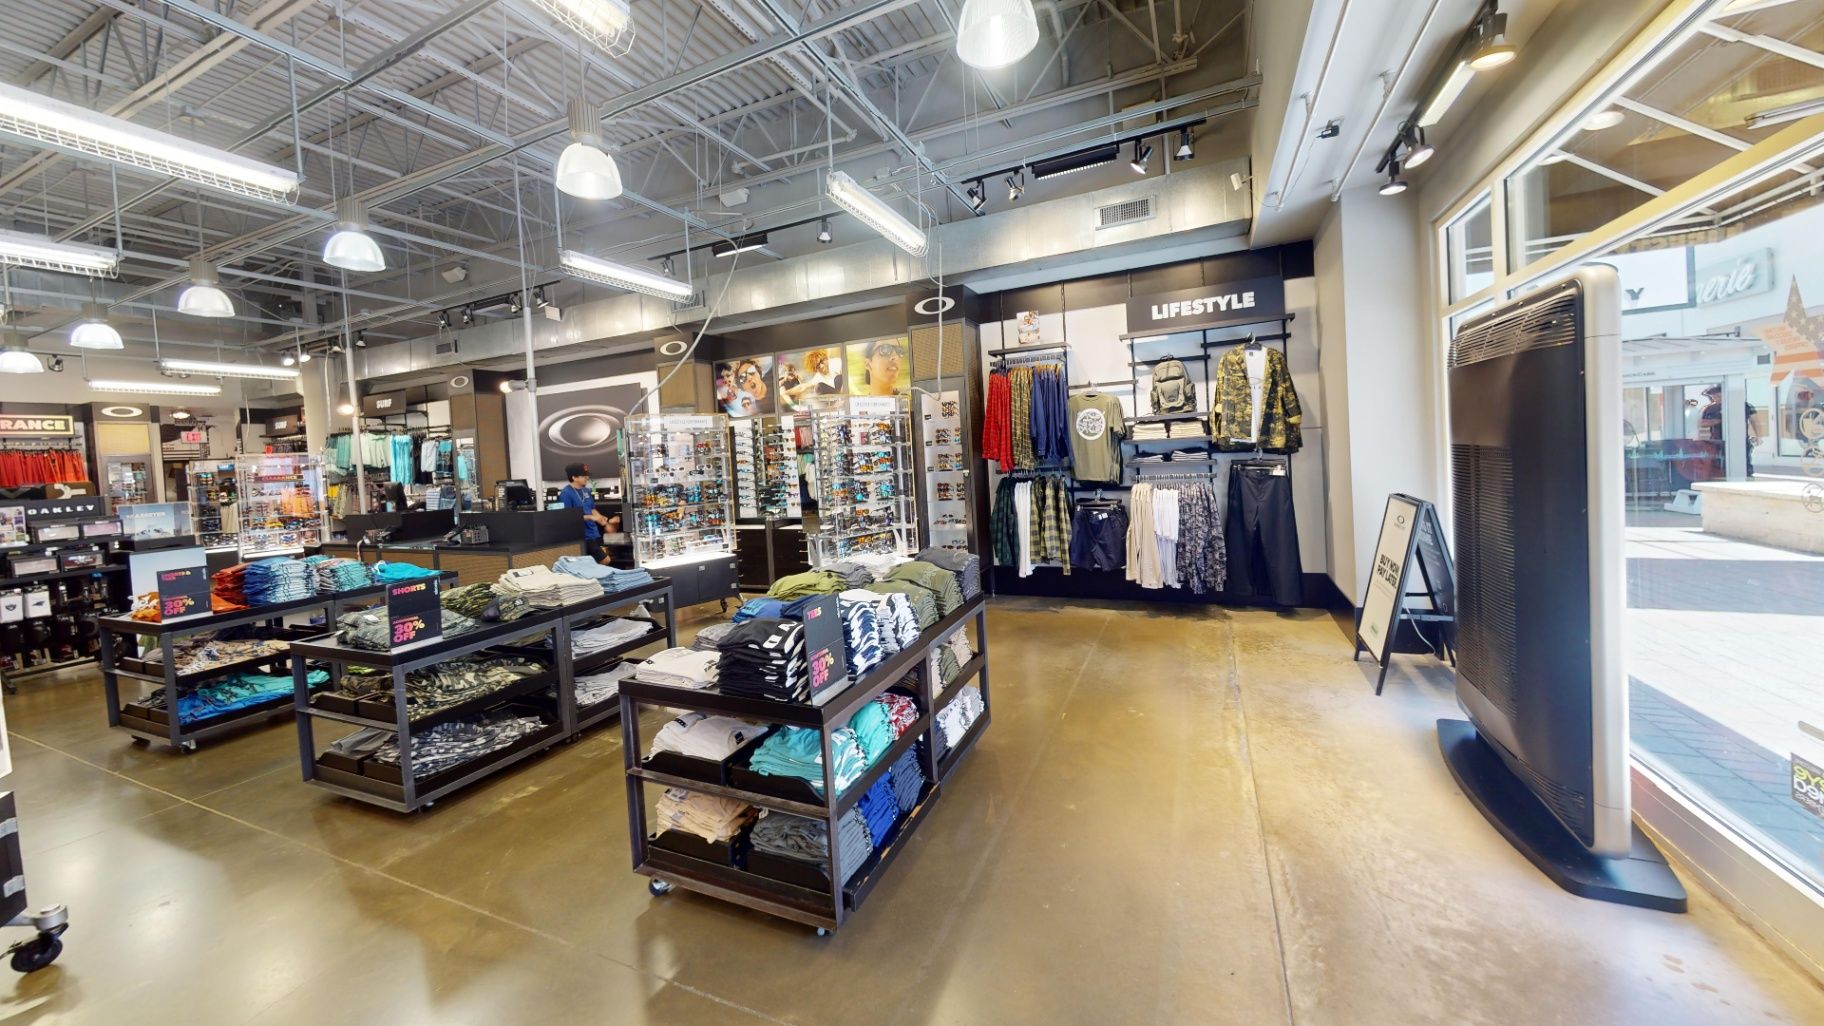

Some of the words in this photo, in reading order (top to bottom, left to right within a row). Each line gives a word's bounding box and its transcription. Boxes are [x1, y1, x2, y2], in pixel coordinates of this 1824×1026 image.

[1152, 291, 1255, 320] LIFESTYLE
[27, 504, 95, 516] OAKLEY
[392, 582, 426, 596] SHORTS
[164, 606, 186, 616] OFF
[394, 619, 426, 637] 30%
[393, 630, 416, 643] OFF
[812, 652, 834, 675] 30%
[813, 668, 829, 688] OFF
